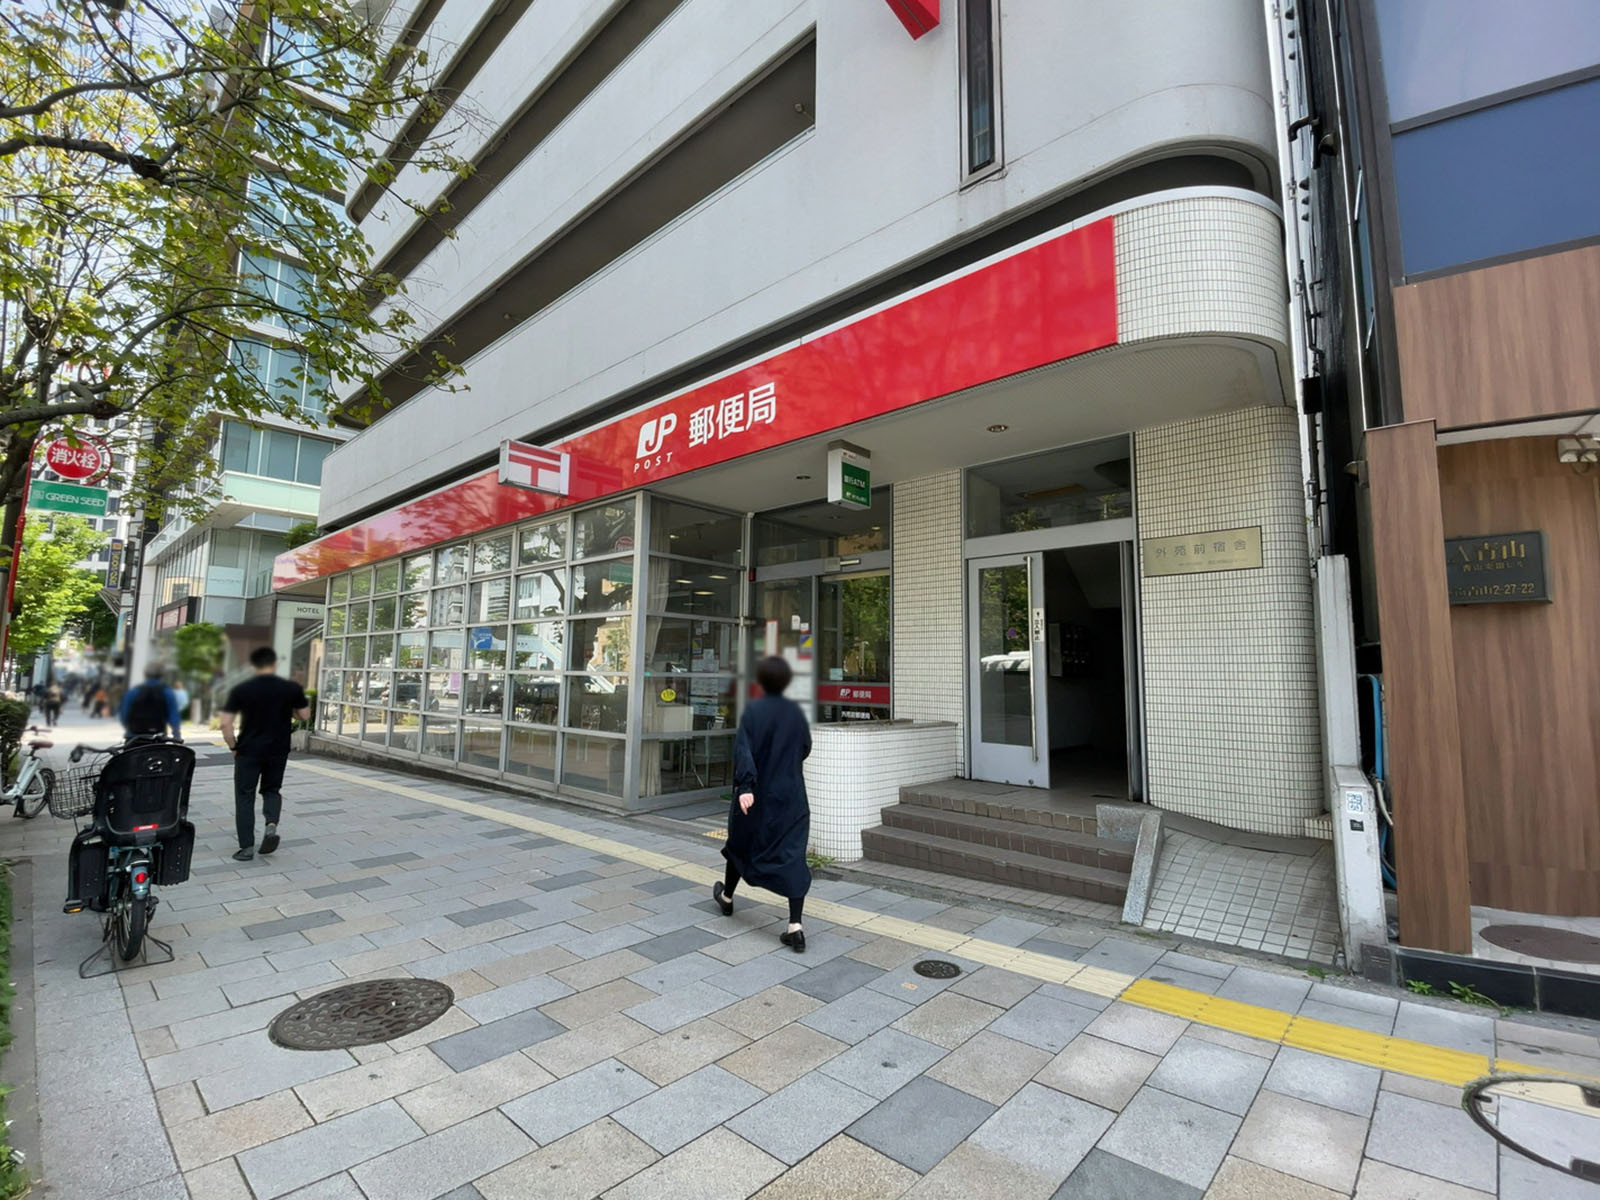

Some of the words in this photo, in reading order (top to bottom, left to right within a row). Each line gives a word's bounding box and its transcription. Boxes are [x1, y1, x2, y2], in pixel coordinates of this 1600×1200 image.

[688, 382, 776, 448] 郵便局
[50, 447, 98, 470] 消火栓
[633, 452, 673, 473] POST
[45, 492, 79, 505] GREEN
[80, 496, 106, 507] SEED
[296, 606, 321, 615] HOTEL
